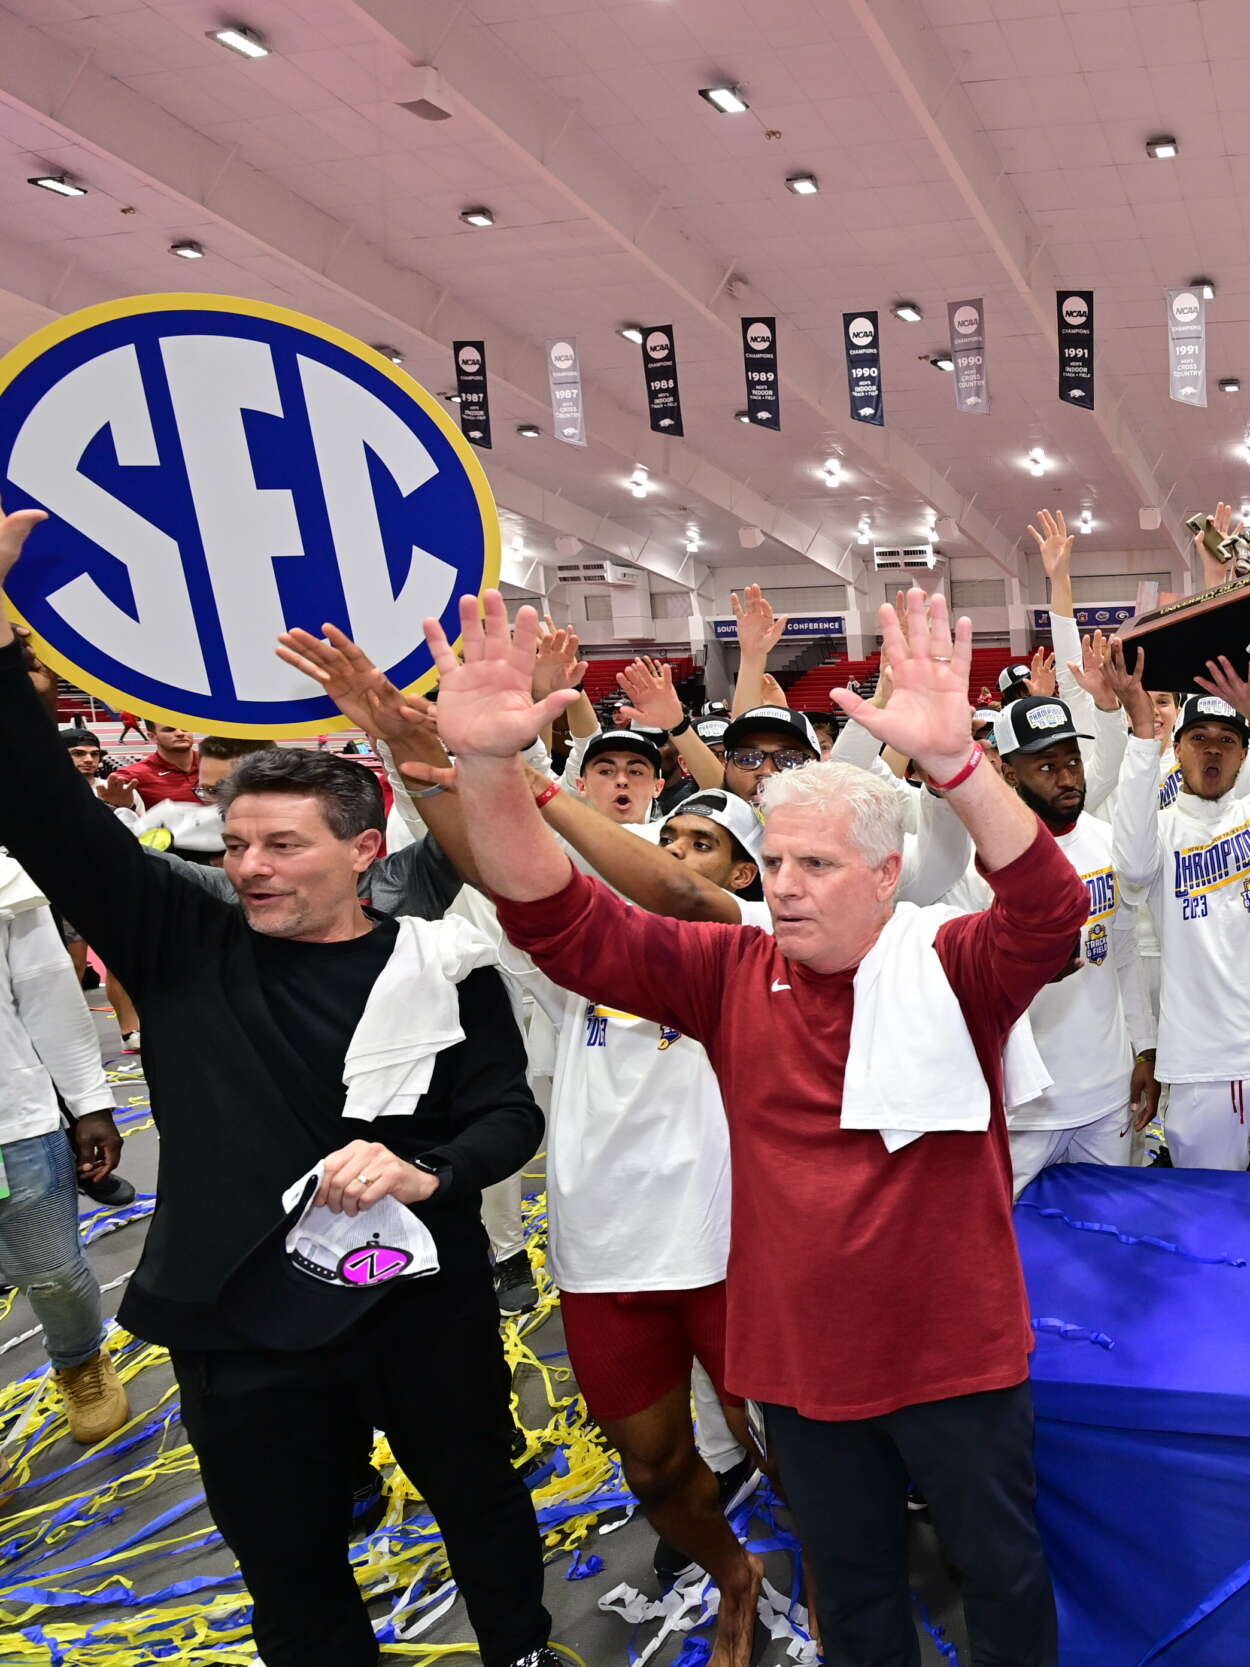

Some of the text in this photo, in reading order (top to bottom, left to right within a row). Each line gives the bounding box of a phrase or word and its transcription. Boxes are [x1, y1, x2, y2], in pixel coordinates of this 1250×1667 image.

[1065, 310, 1088, 318] NCAA
[1175, 306, 1199, 315] NCAA
[957, 318, 978, 327] NCAA
[749, 335, 770, 343] NCAA
[649, 343, 670, 351] NCAA
[1175, 345, 1199, 356] 1991
[1064, 348, 1088, 358] 1991
[958, 356, 982, 367] 1990
[747, 371, 775, 381] 1989
[852, 368, 878, 378] 1990
[650, 379, 675, 390] 1988
[461, 393, 484, 402] 1987
[555, 389, 578, 399] 1987
[7, 334, 458, 703] SEC
[787, 621, 840, 630] CONFERENCE
